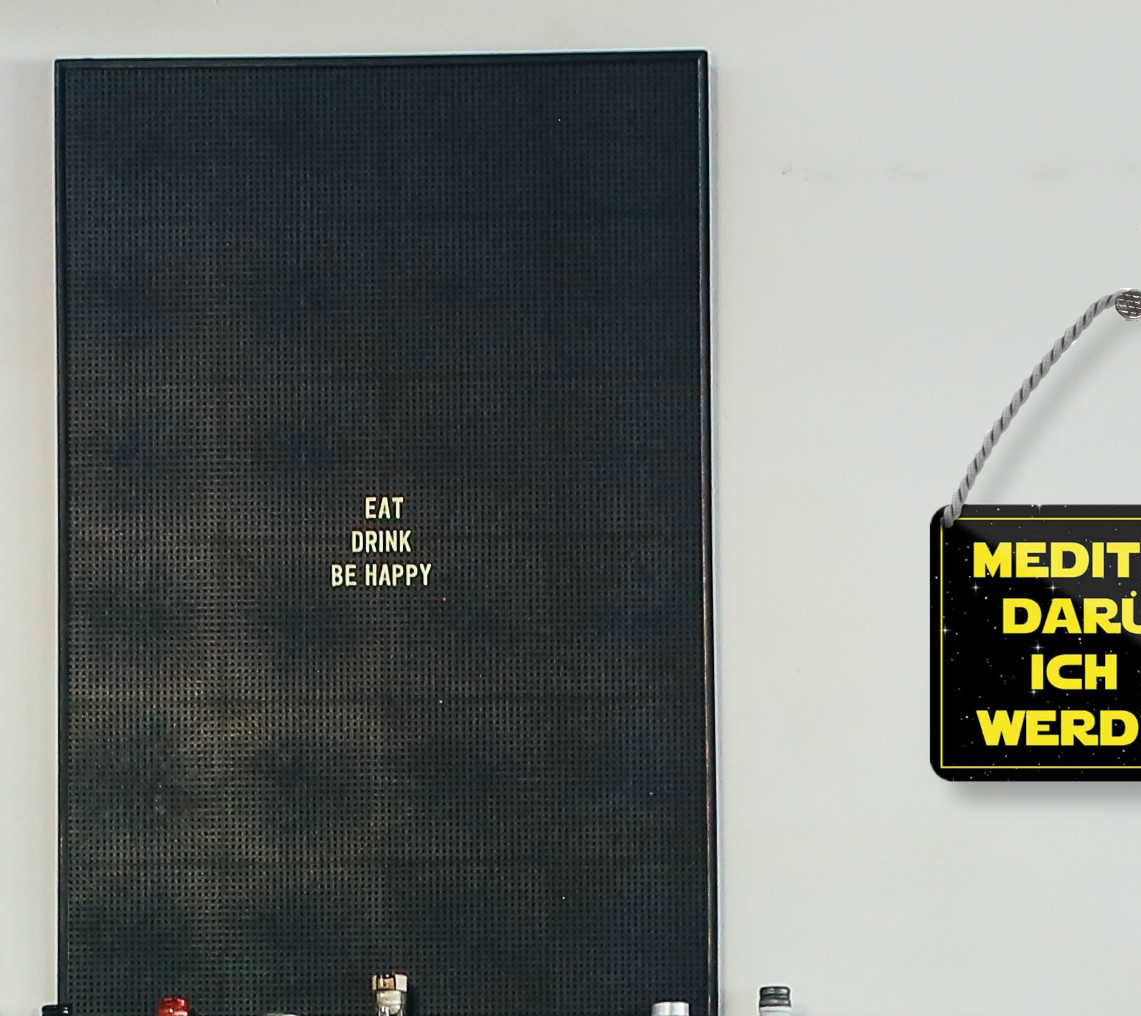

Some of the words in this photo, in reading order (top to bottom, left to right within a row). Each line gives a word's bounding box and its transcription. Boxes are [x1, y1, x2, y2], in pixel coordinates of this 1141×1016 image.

[365, 496, 404, 519] EAT
[351, 529, 412, 553] DRINK
[331, 563, 357, 587] BE
[365, 563, 432, 587] HAPPY
[1031, 653, 1118, 690] ICH
